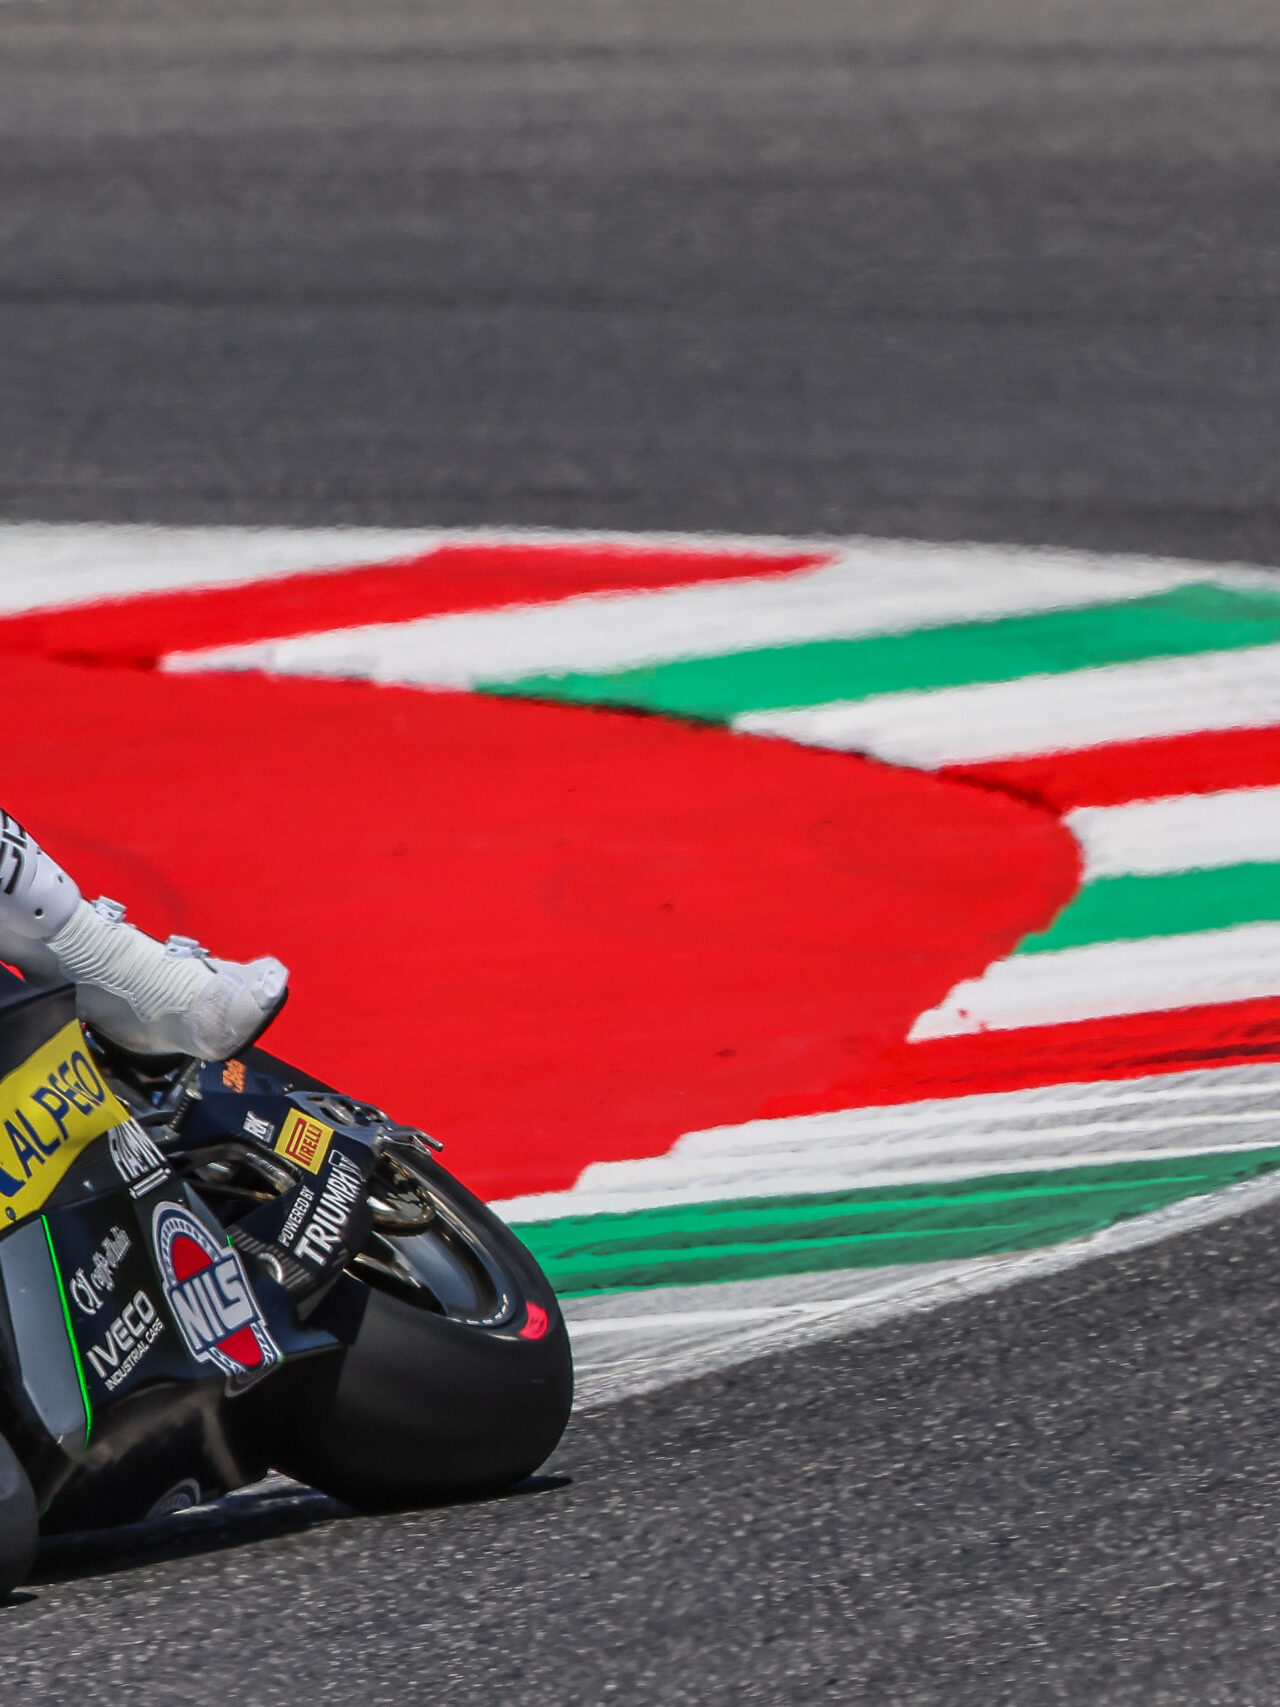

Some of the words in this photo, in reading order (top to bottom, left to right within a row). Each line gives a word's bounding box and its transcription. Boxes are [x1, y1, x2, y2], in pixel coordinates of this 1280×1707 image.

[285, 1116, 323, 1167] PIRELLI
[278, 1200, 309, 1248] POWERED
[299, 1185, 315, 1202] BY
[86, 1289, 156, 1379] IVECO
[172, 1258, 253, 1350] NILS
[105, 1340, 150, 1392] INDUSTRIAL
[145, 1317, 164, 1344] CARS
